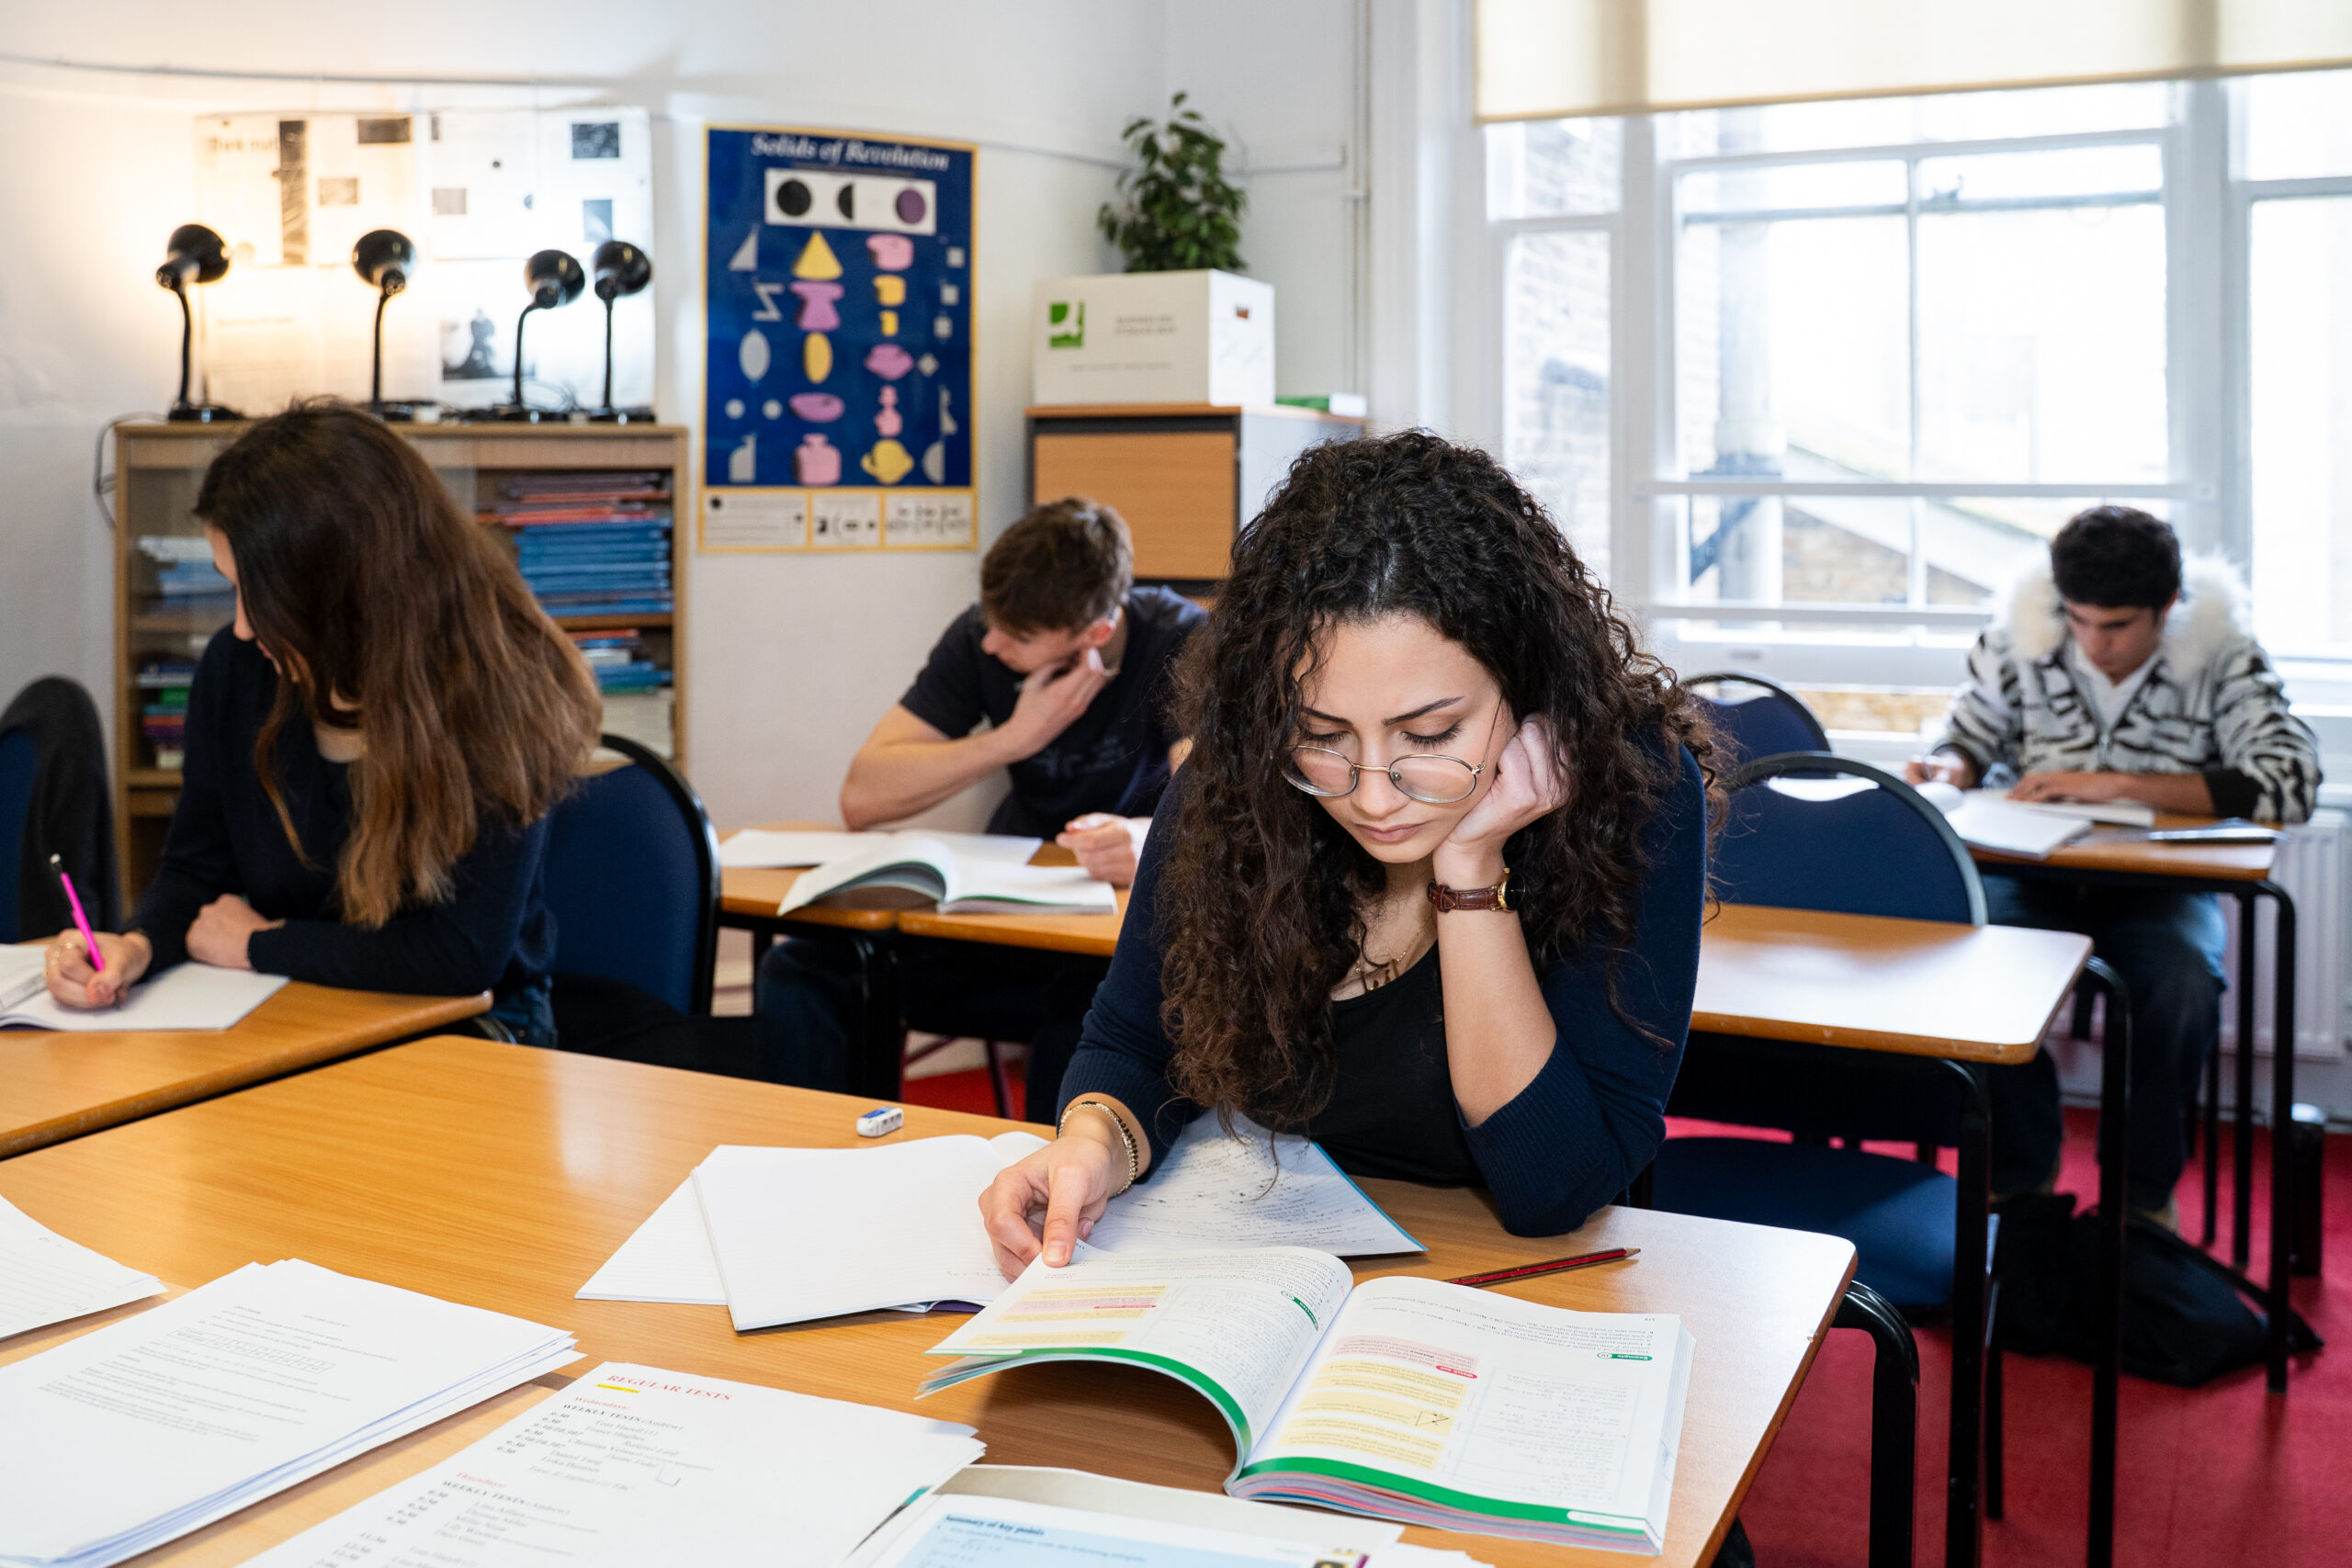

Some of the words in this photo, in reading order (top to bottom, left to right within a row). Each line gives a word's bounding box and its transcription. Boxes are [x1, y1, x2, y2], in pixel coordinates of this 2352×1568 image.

[751, 132, 819, 159] Solids
[820, 139, 844, 164] of
[844, 140, 949, 169] Revolution
[606, 1375, 682, 1393] REGULAR
[685, 1388, 733, 1401] TESTS
[563, 1404, 606, 1416] WEEKLY
[610, 1412, 641, 1422] TESTS
